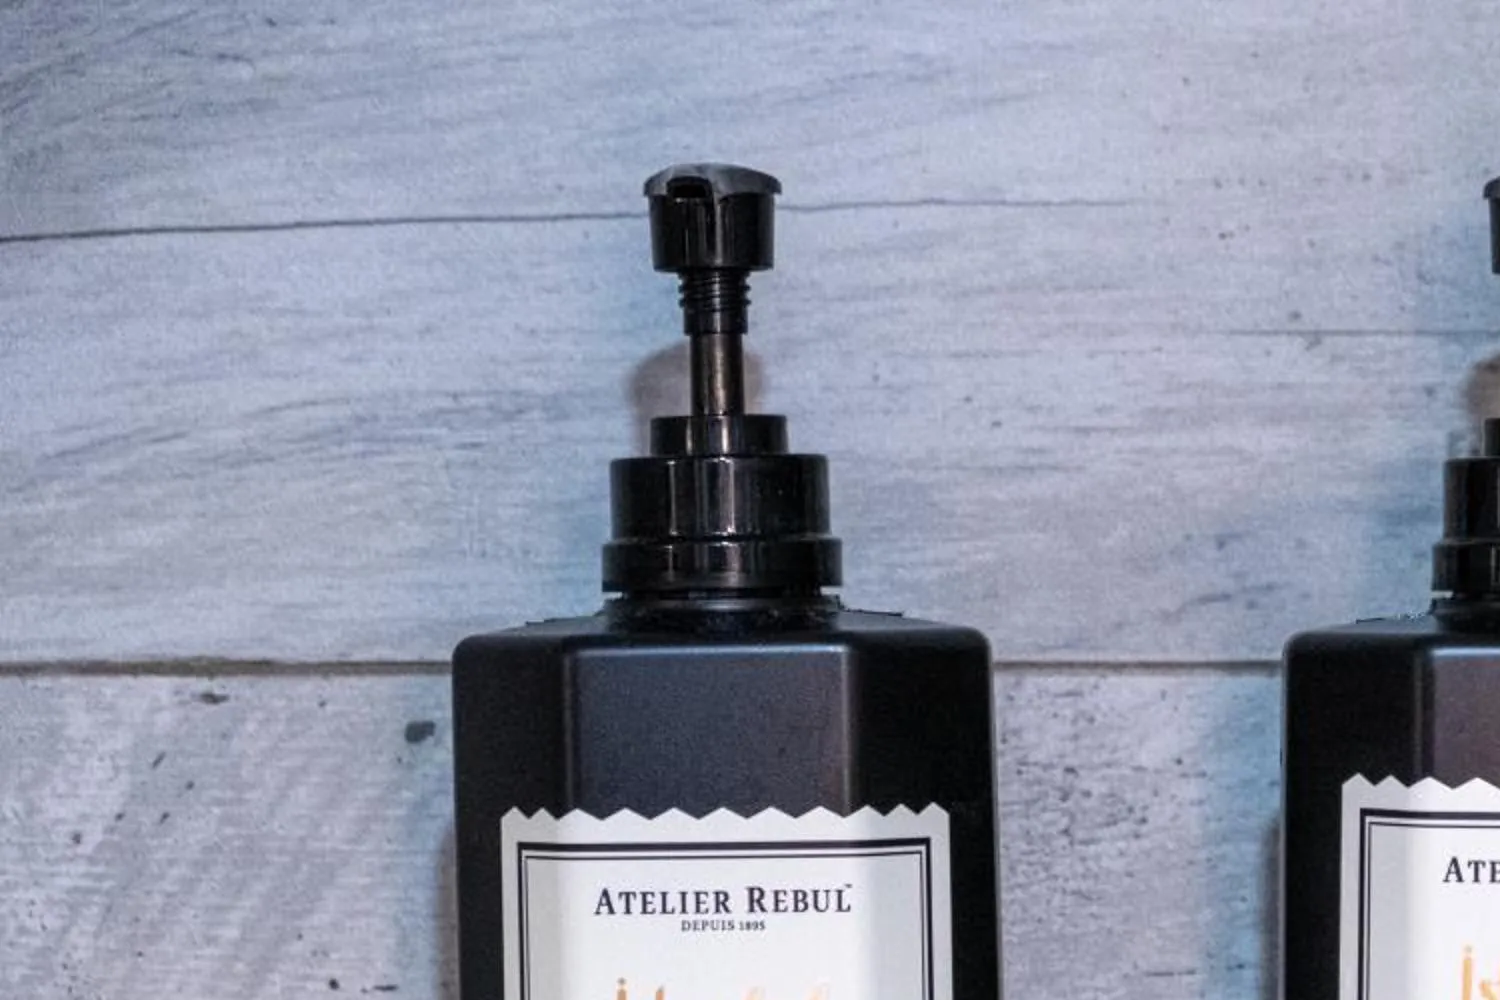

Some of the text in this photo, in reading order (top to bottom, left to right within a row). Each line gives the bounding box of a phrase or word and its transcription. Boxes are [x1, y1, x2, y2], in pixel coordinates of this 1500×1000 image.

[594, 888, 731, 915] ATELIER
[681, 920, 766, 932] DEPUIS 1895
